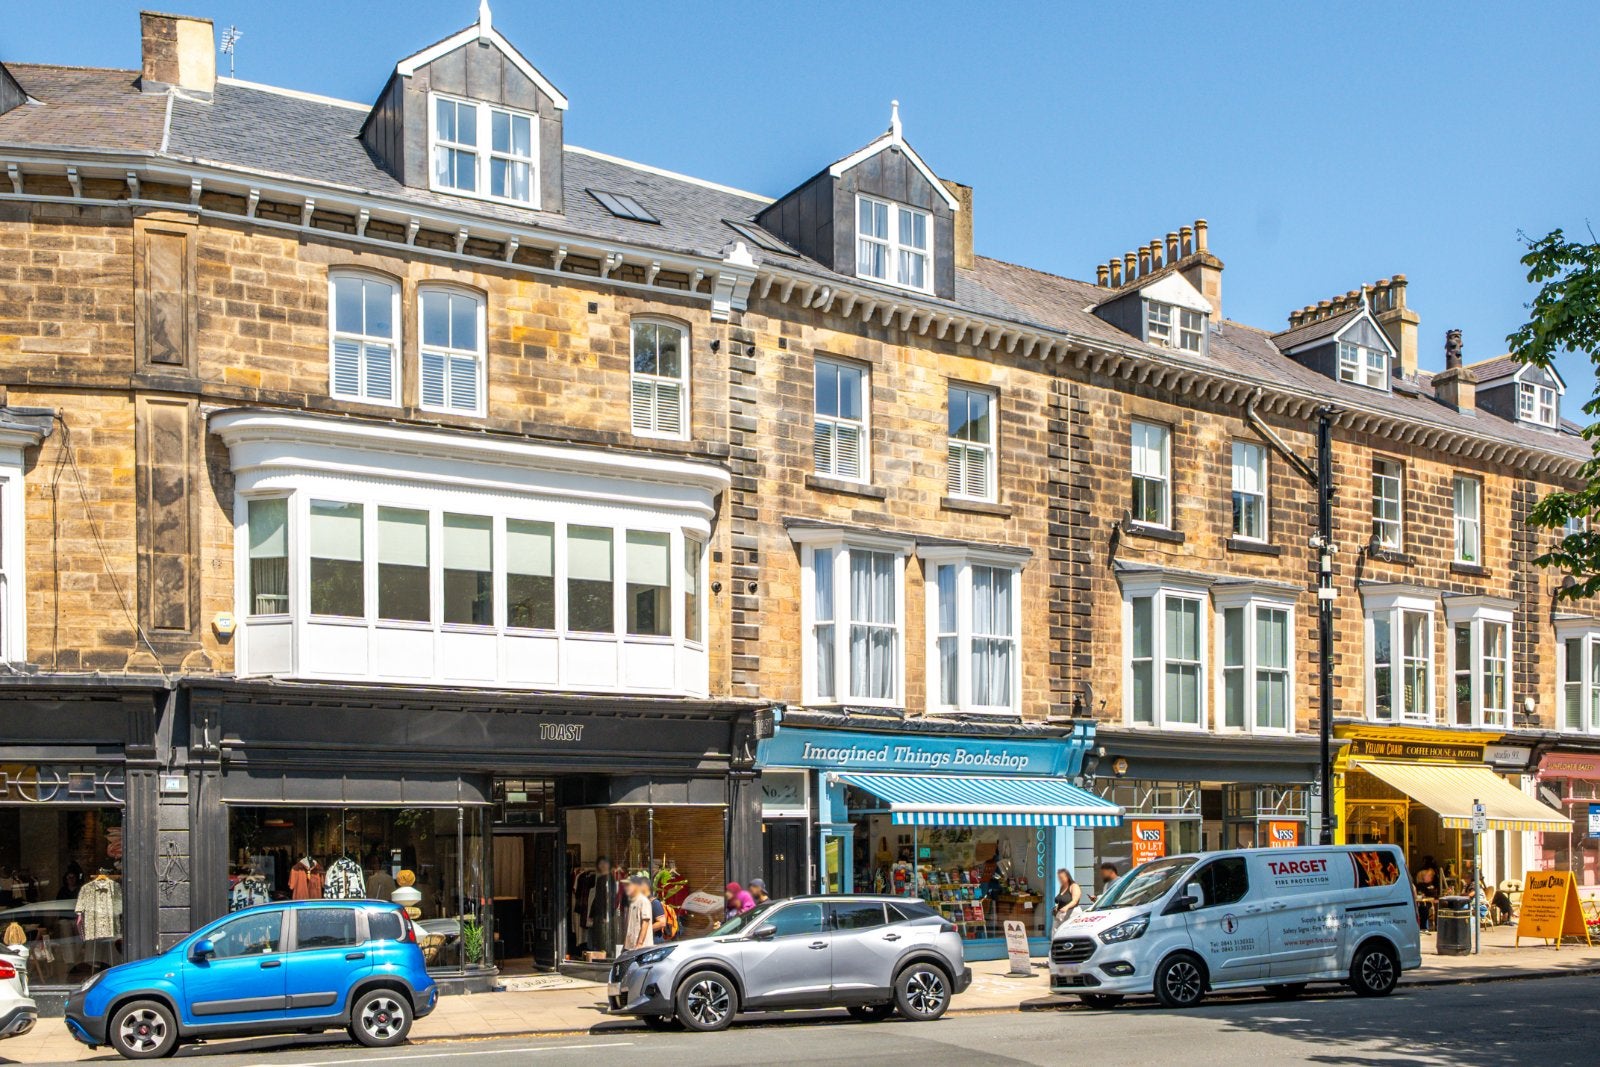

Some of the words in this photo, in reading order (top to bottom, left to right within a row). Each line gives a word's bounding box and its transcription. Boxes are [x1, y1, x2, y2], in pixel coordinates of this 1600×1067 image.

[539, 723, 585, 741] TOAST
[802, 742, 889, 765] Imagined
[893, 746, 950, 768] Things
[953, 749, 1029, 771] Bookshop
[1365, 742, 1386, 754] YELLOW
[1387, 743, 1403, 755] CHAIR
[1406, 746, 1429, 755] COFFEE
[1430, 747, 1451, 756] HOUSE
[1134, 842, 1147, 851] TO
[1147, 842, 1163, 851] LET
[1268, 859, 1327, 875] TARGET
